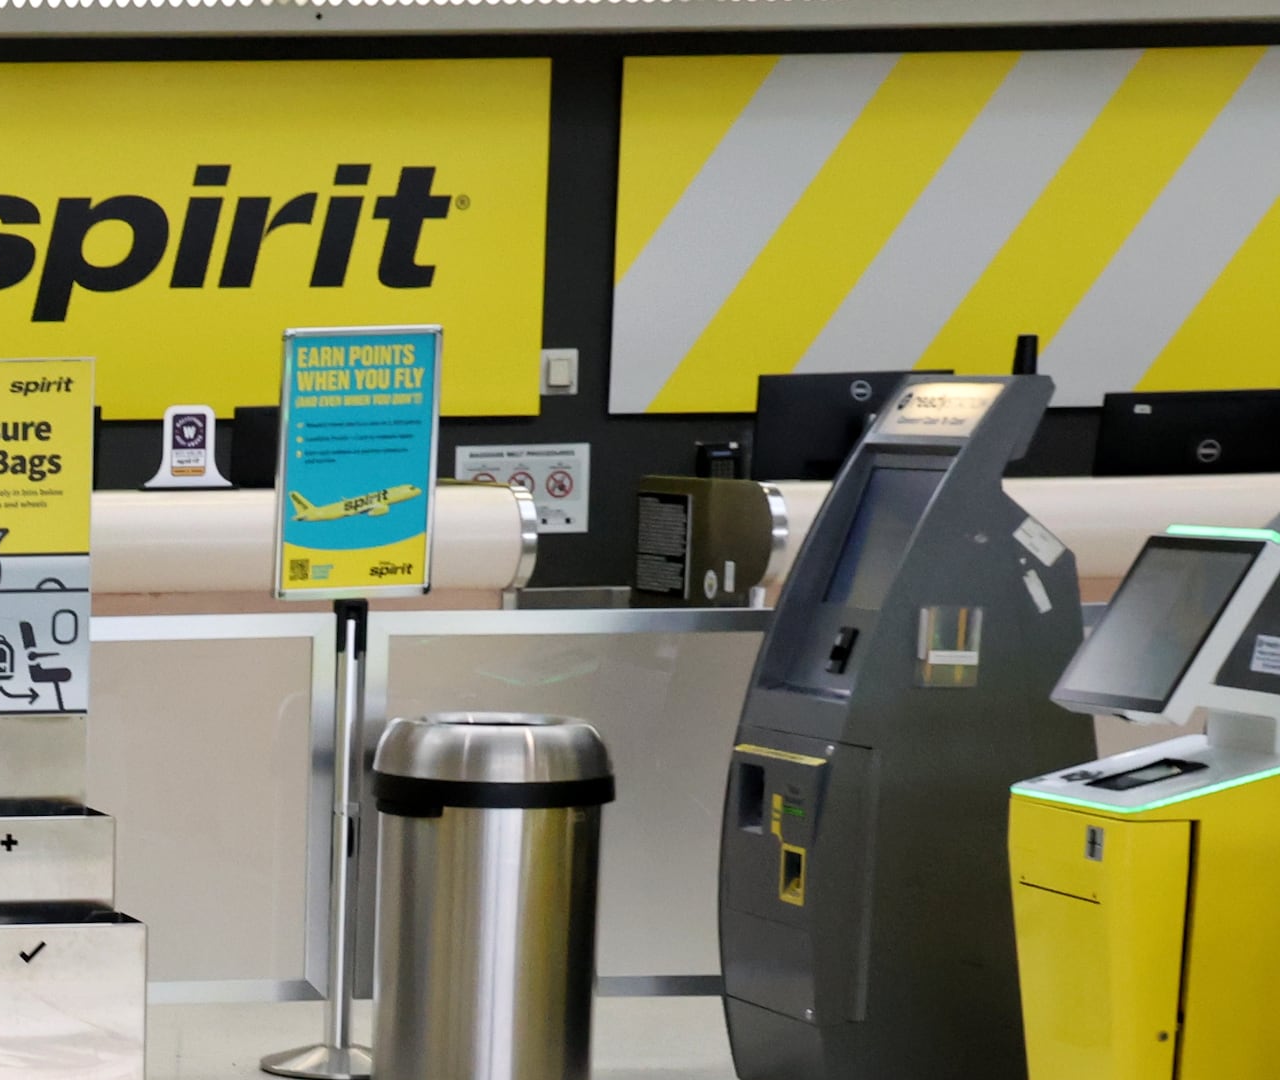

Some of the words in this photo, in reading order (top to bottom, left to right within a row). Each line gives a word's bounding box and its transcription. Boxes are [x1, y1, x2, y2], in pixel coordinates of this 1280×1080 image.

[298, 346, 345, 368] EARN
[349, 344, 416, 367] POINTS
[9, 376, 74, 396] spirit
[297, 369, 350, 391] WHEN
[354, 368, 391, 390] YOU
[394, 367, 425, 389] FLY
[20, 500, 47, 508] wheels
[343, 489, 389, 512] spirit
[369, 563, 414, 578] spirit
